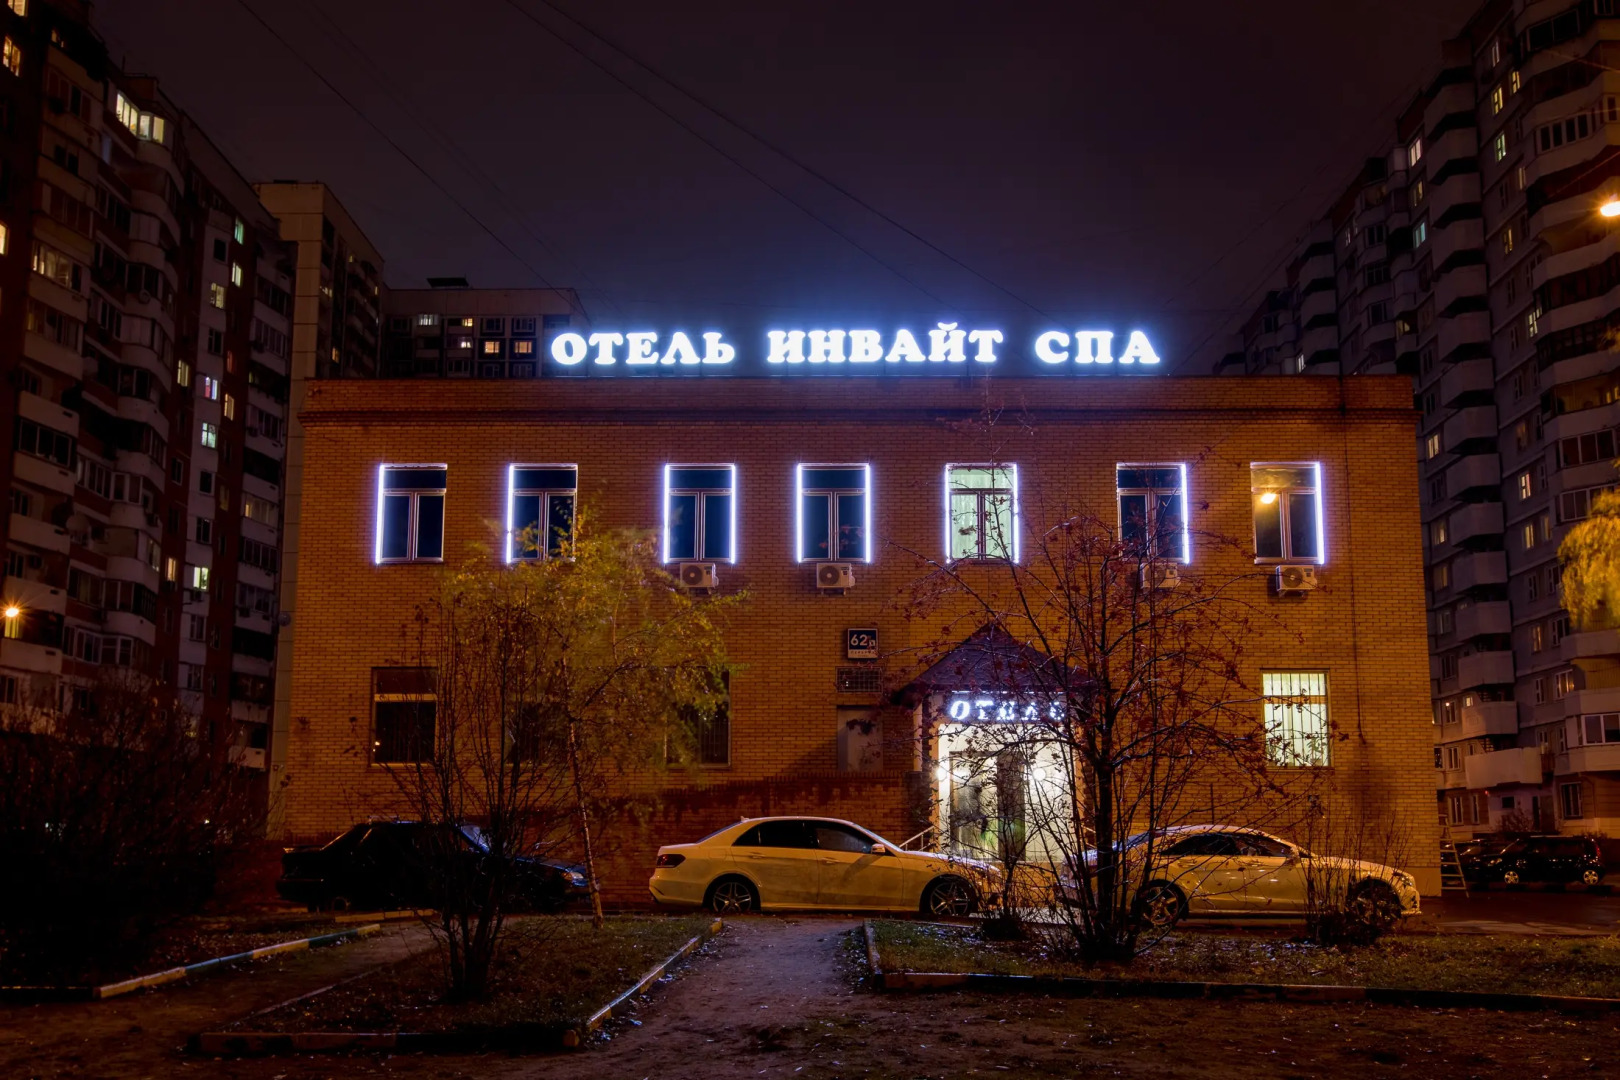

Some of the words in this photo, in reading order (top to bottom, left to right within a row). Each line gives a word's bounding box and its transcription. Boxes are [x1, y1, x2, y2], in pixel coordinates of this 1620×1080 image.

[551, 331, 735, 365] ОТЕЛЬ
[767, 322, 1003, 363] ИНВАЙТ
[1035, 330, 1160, 364] СПА
